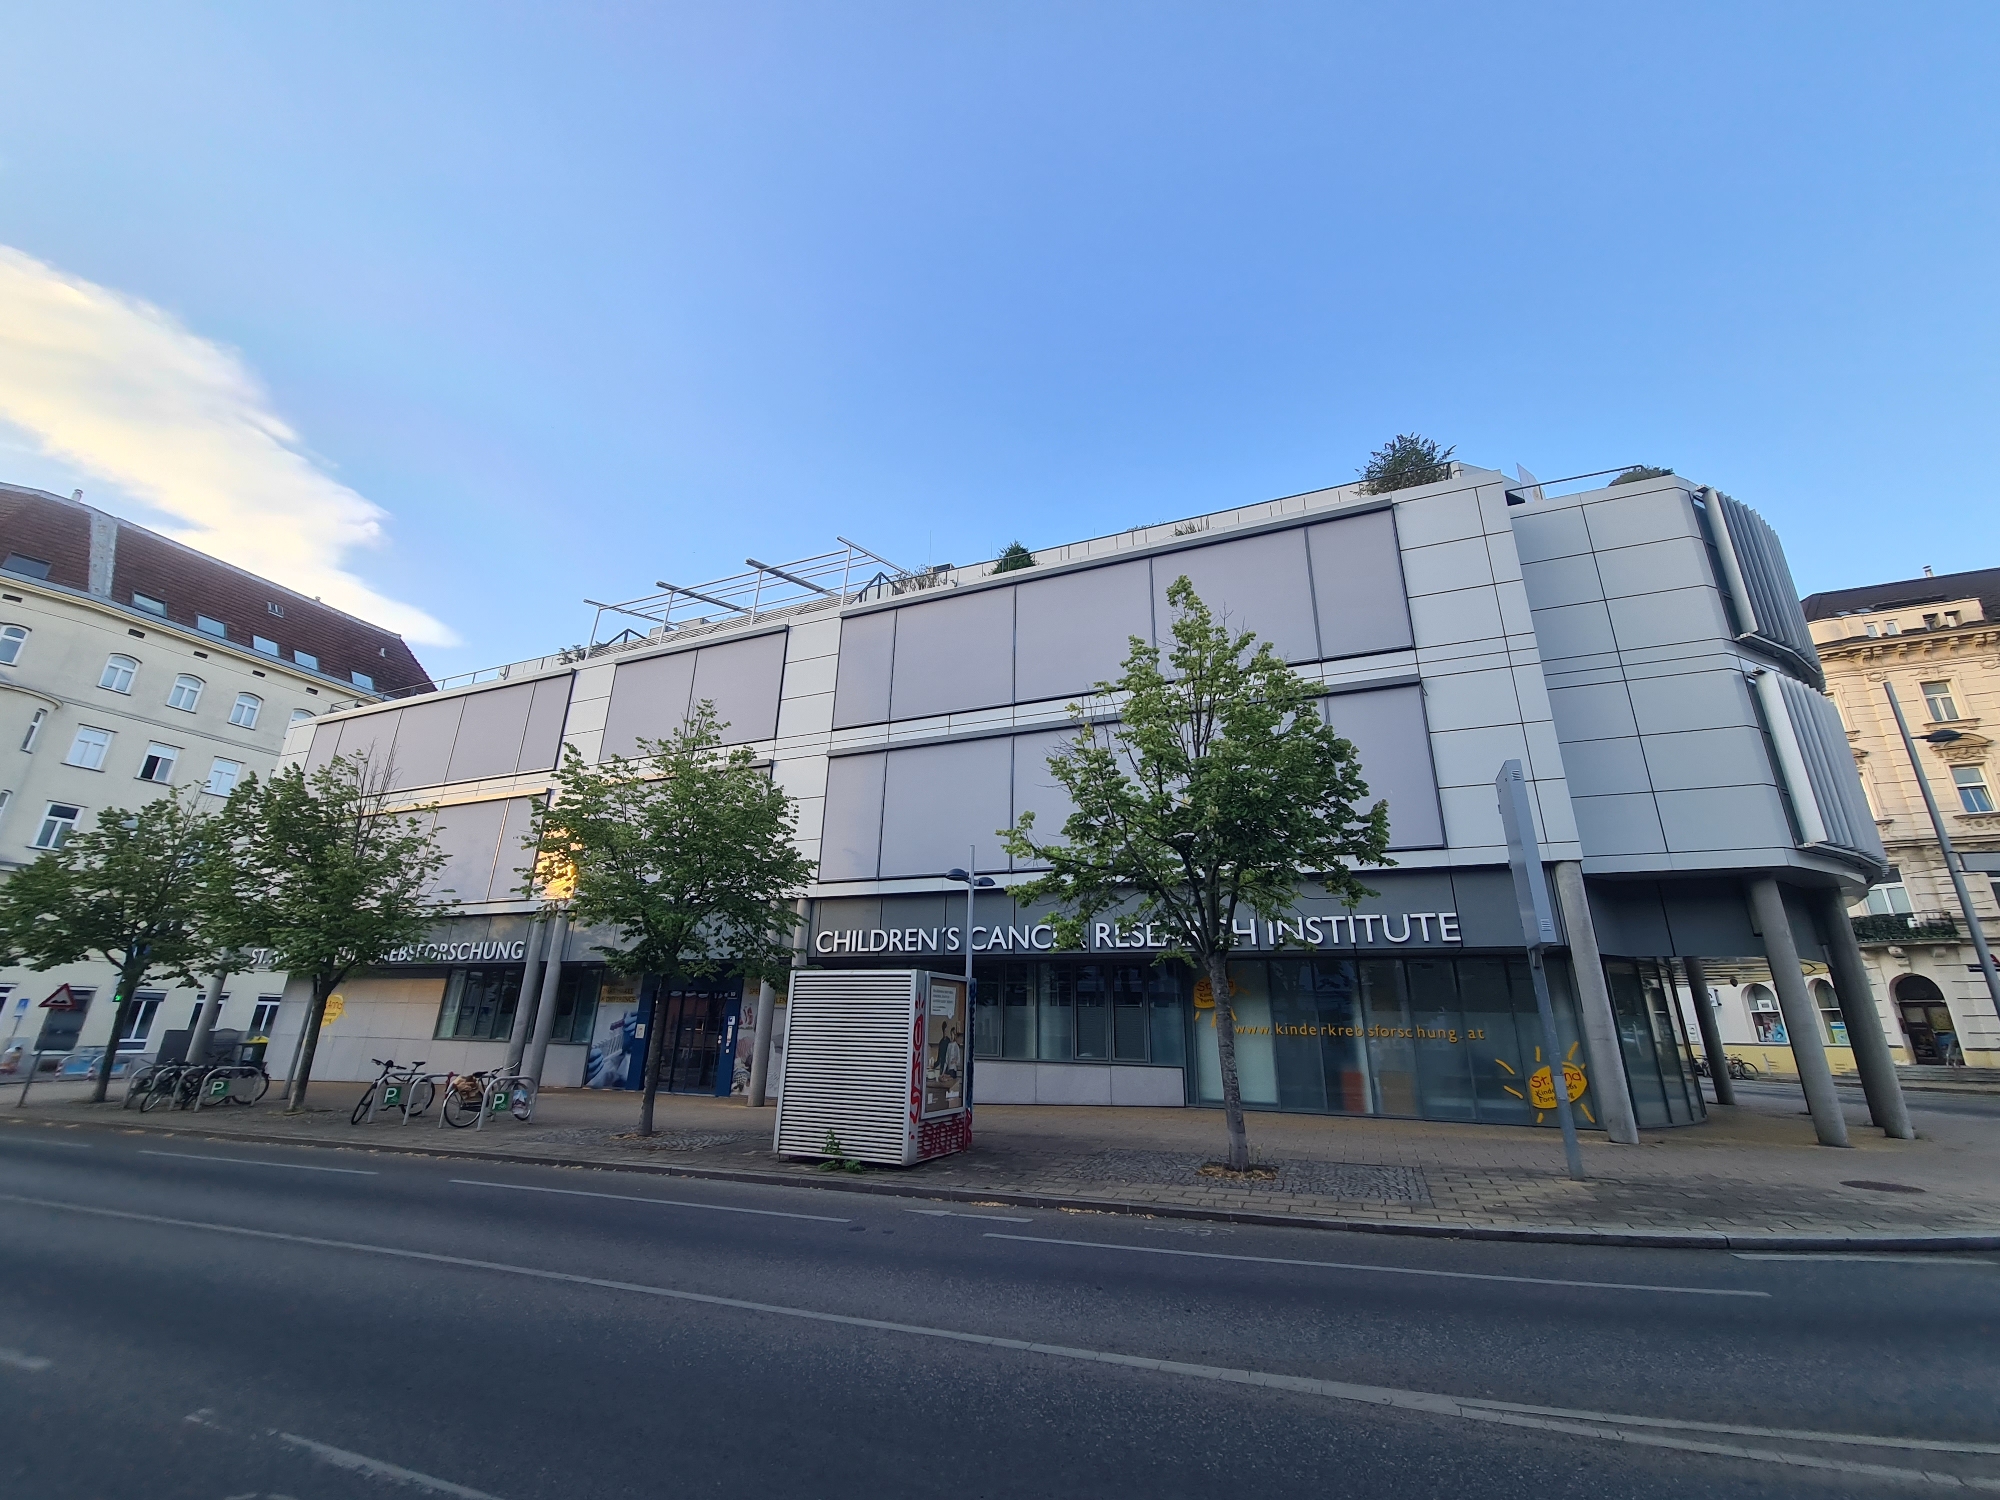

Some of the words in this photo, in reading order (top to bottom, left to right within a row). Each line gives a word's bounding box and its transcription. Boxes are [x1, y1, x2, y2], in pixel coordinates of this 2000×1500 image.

[971, 925, 1086, 951] CANC
[1267, 912, 1462, 945] INSTITUTE
[210, 1081, 225, 1095] P
[1531, 1075, 1550, 1089] St.
[383, 1087, 398, 1103] P
[491, 1093, 505, 1110] P
